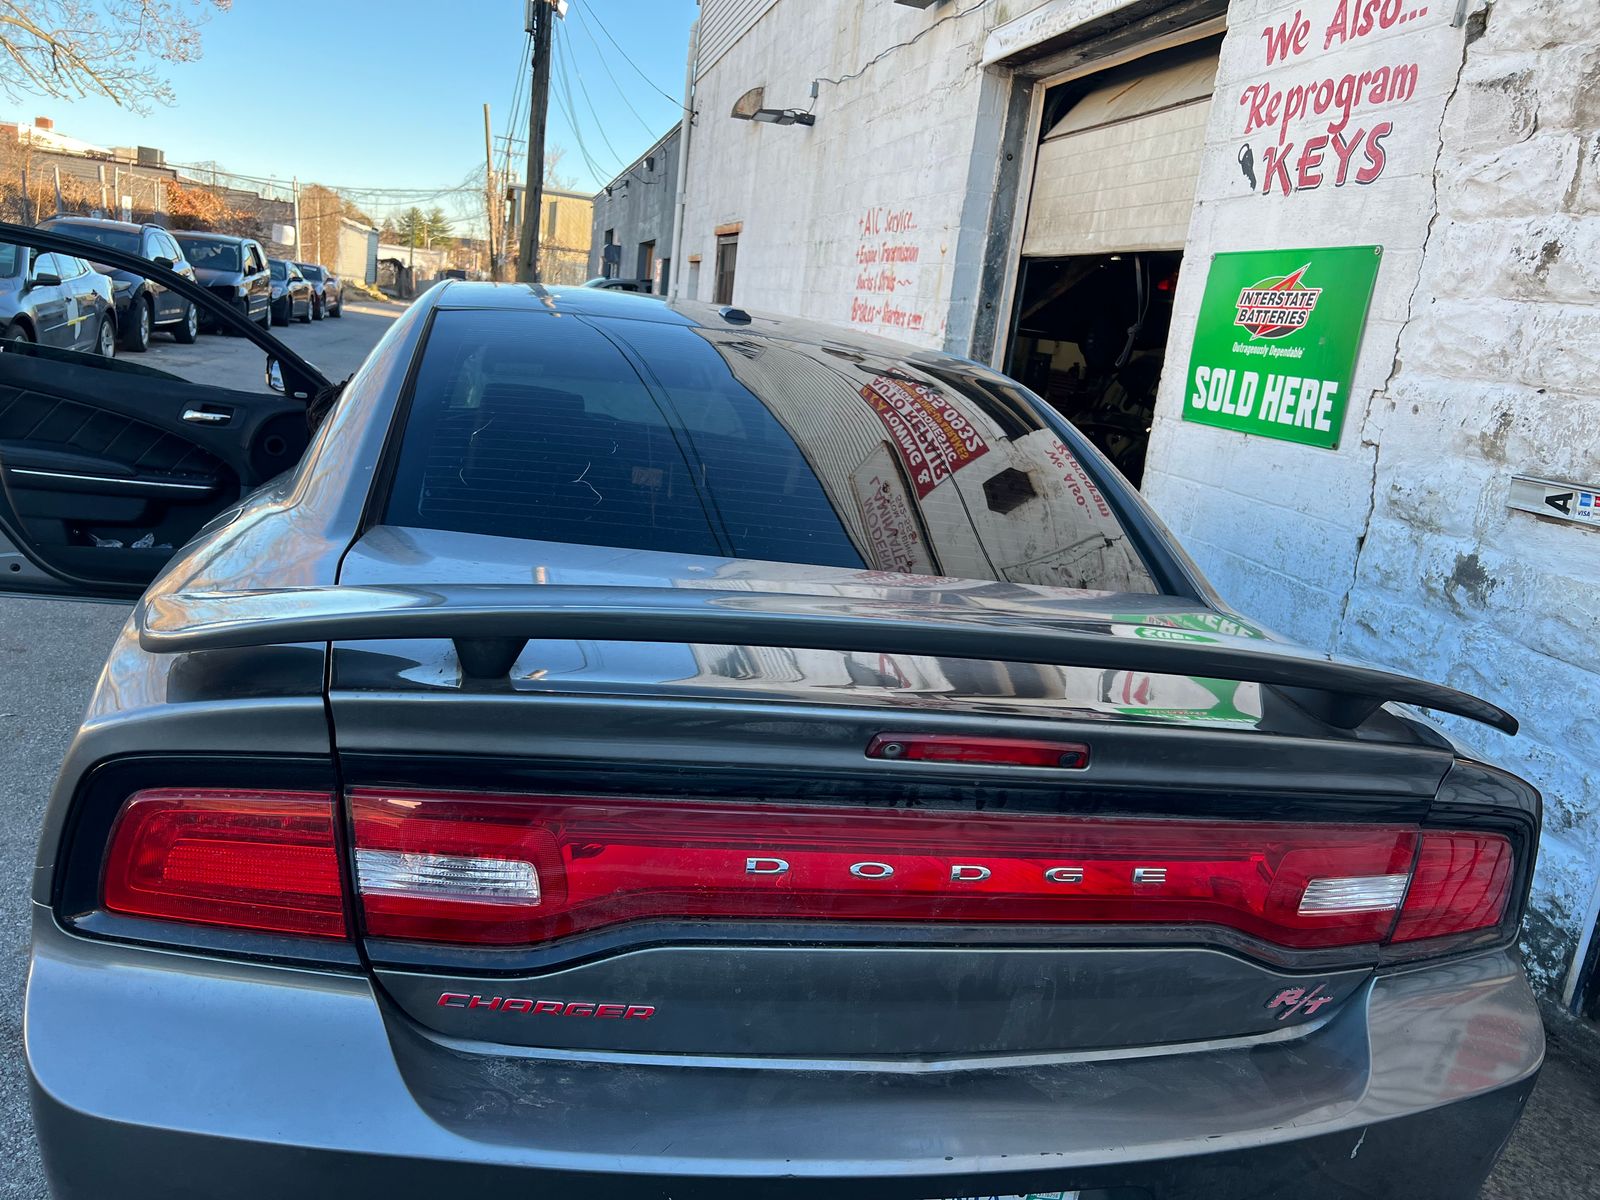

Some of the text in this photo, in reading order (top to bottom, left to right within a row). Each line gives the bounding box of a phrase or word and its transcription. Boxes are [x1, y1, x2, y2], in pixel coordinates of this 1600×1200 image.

[1262, 9, 1311, 66] We
[1240, 63, 1418, 146] Reprogram
[1262, 121, 1393, 196] KEYS
[1238, 309, 1307, 325] BATTERIES
[1239, 291, 1316, 307] INTERSTATE
[1192, 365, 1339, 432] SOLD HERE
[745, 857, 1168, 884] DODGE
[436, 992, 656, 1020] CHARGER
[1266, 983, 1334, 1020] R/T
